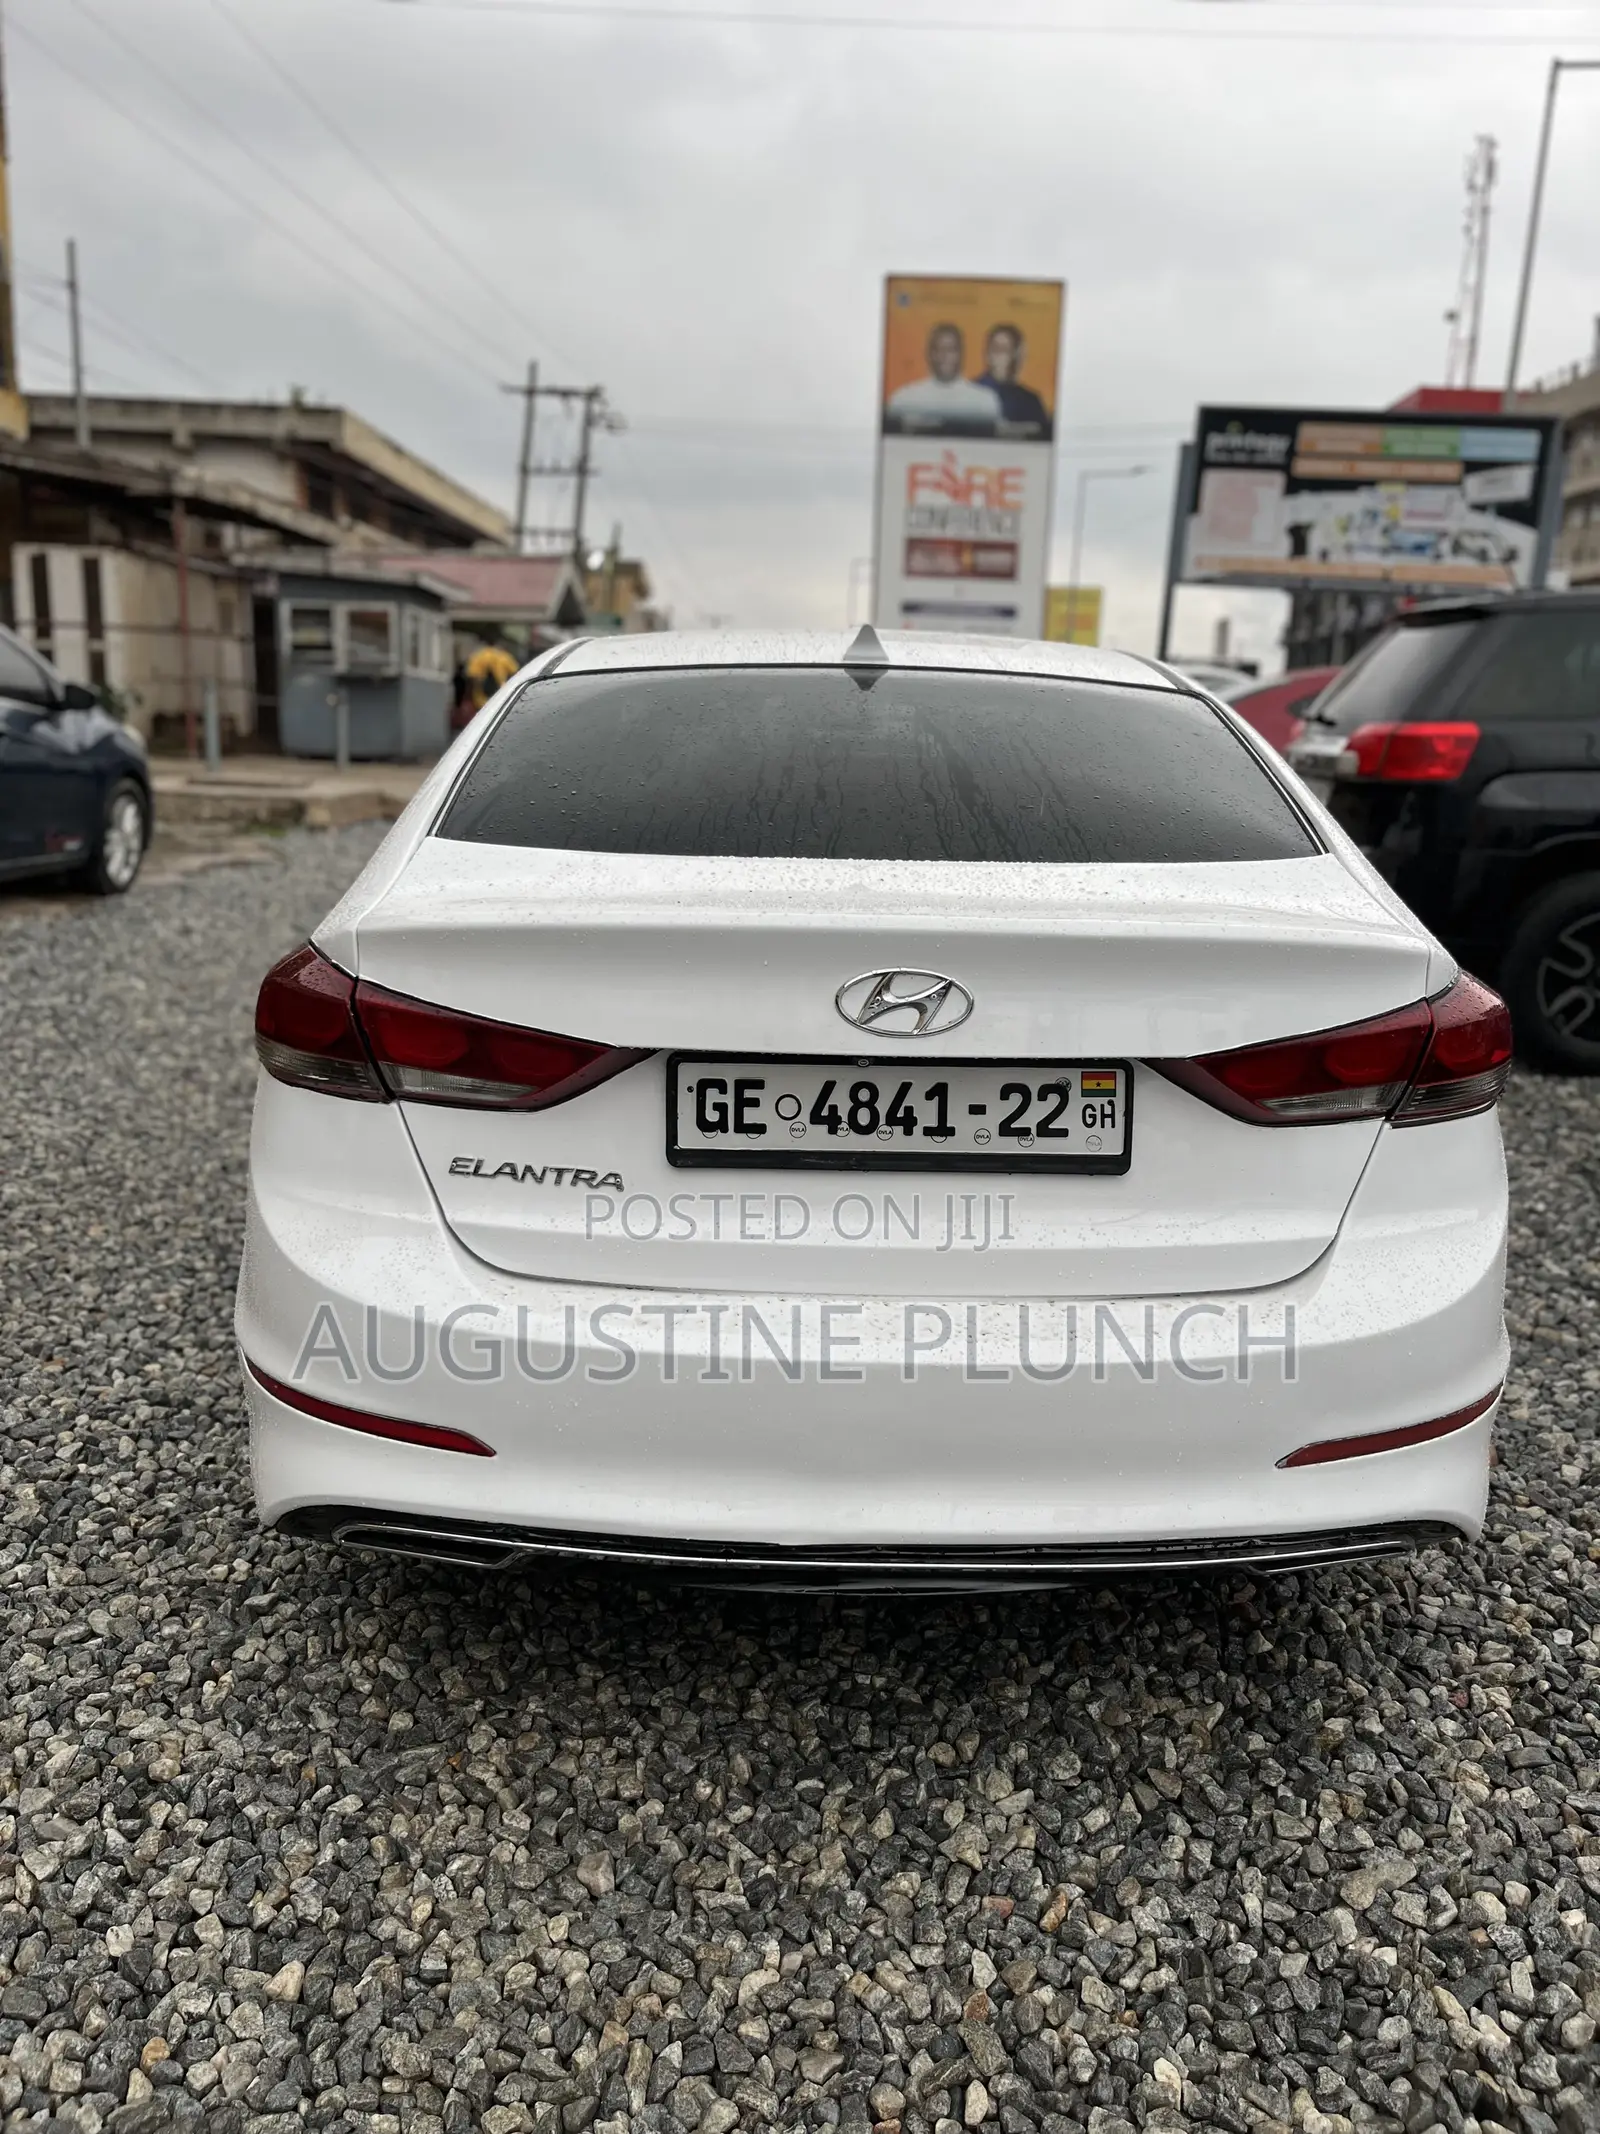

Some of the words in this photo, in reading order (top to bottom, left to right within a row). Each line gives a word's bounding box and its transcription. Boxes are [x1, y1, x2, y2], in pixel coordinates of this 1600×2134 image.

[695, 1078, 768, 1135] GE
[809, 1079, 1073, 1138] 4841-22
[1081, 1102, 1116, 1129] GH
[447, 1155, 626, 1193] ELANTRA
